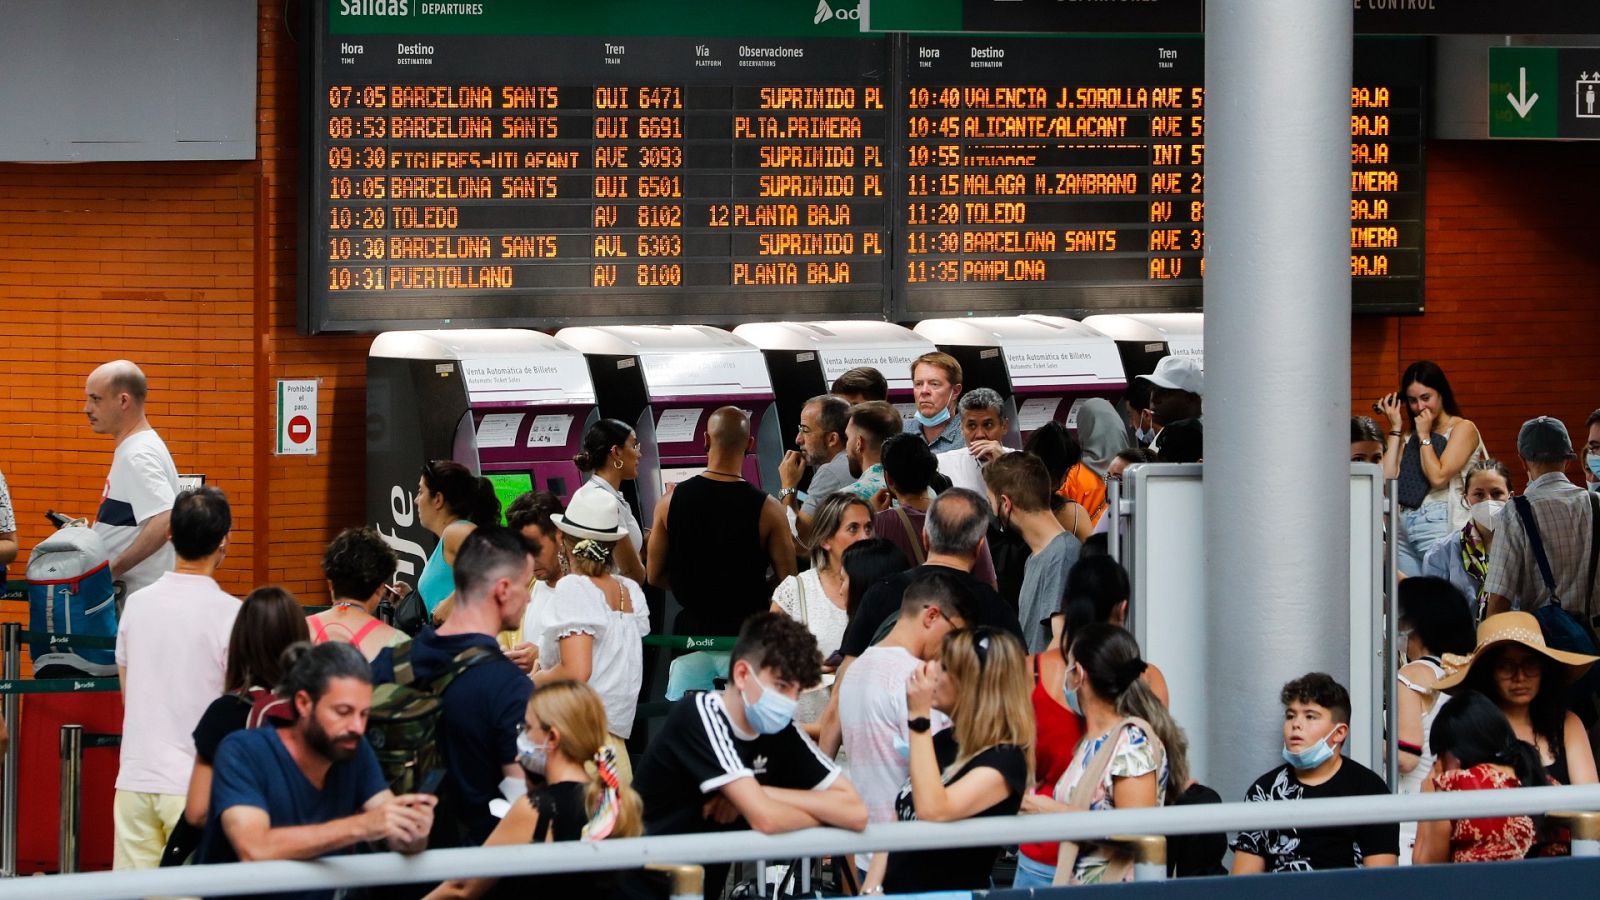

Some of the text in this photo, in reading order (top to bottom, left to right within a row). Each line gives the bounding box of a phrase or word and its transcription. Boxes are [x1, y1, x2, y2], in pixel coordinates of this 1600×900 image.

[341, 0, 482, 15] Salidas DEPARTURES
[834, 3, 861, 20] ad
[1369, 0, 1435, 9] CONTROL
[342, 43, 803, 57] Hora Destino Tren Vía Observaciones
[920, 47, 1177, 58] Hora Destino Tren
[330, 86, 385, 107] 07:05
[392, 87, 492, 108] BARCELONA
[503, 87, 557, 108] SANTS
[640, 88, 682, 108] 6471
[761, 88, 854, 108] SUPRIMIDO
[865, 88, 883, 108] PL
[910, 88, 959, 108] 10:40
[965, 88, 1046, 108] VALENCIA
[1057, 88, 1147, 108] J.SOROLLA
[1152, 88, 1182, 108] AVE
[1351, 88, 1388, 107] BAJA
[330, 117, 385, 138] 08:53
[392, 117, 491, 138] BARCELONA
[503, 117, 557, 138] SANTS
[639, 117, 681, 138] 6691
[909, 117, 959, 137] 10:45
[965, 117, 1127, 137] ALICANTE/ALACANT
[1152, 117, 1182, 136] AVE
[1351, 116, 1388, 135] BAJA
[329, 147, 385, 168] 09:30
[596, 147, 627, 167] AVE
[640, 147, 681, 167] 3093
[761, 146, 854, 167] SUPRIMIDO
[865, 147, 882, 166] PL
[909, 146, 959, 166] 10:55
[1153, 145, 1181, 164] INT
[1350, 144, 1388, 163] BAJA
[331, 177, 385, 198] 10:05
[391, 177, 491, 198] BARCELONA
[503, 177, 557, 198] SANTS
[639, 176, 681, 197] 6501
[760, 176, 853, 196] SUPRIMIDO
[865, 175, 882, 195] PL
[909, 175, 959, 195] 11:15
[964, 174, 1025, 194] MALAGA
[1036, 174, 1136, 194] M.ZAMBRANO
[1152, 173, 1181, 193] AVE
[1351, 172, 1398, 191] IMERA
[331, 205, 849, 229] 10:20 TOLEDO AV 8102 12 PLANTA BAJA
[909, 204, 959, 224] 11:20
[966, 203, 1025, 223] TOLEDO
[1151, 202, 1171, 222] AV
[1350, 200, 1387, 219] BAJA
[330, 233, 882, 261] 10:30 BARCELONA SANTS AVL 6303 SUPRIMIDO PL
[908, 232, 958, 253] 11:30
[964, 232, 1055, 252] BARCELONA
[1066, 231, 1116, 251] SANTS
[1151, 230, 1181, 250] AVE
[1350, 227, 1397, 247] IMERA
[330, 263, 849, 291] 10:31 PUERTOLLANO AV 8100 PLANTA BAJA
[908, 261, 958, 282] 11:35
[963, 260, 1045, 281] PAMPLONA
[1150, 258, 1181, 278] ALV
[824, 357, 843, 365] Venta
[880, 356, 887, 364] de
[888, 355, 912, 363] Billetes
[1069, 352, 1092, 360] Billetes
[466, 367, 485, 376] Venta
[524, 366, 532, 374] de
[533, 365, 558, 374] Billetes
[287, 385, 314, 393] Prohibido
[298, 394, 305, 402] el
[696, 638, 714, 646] adif
